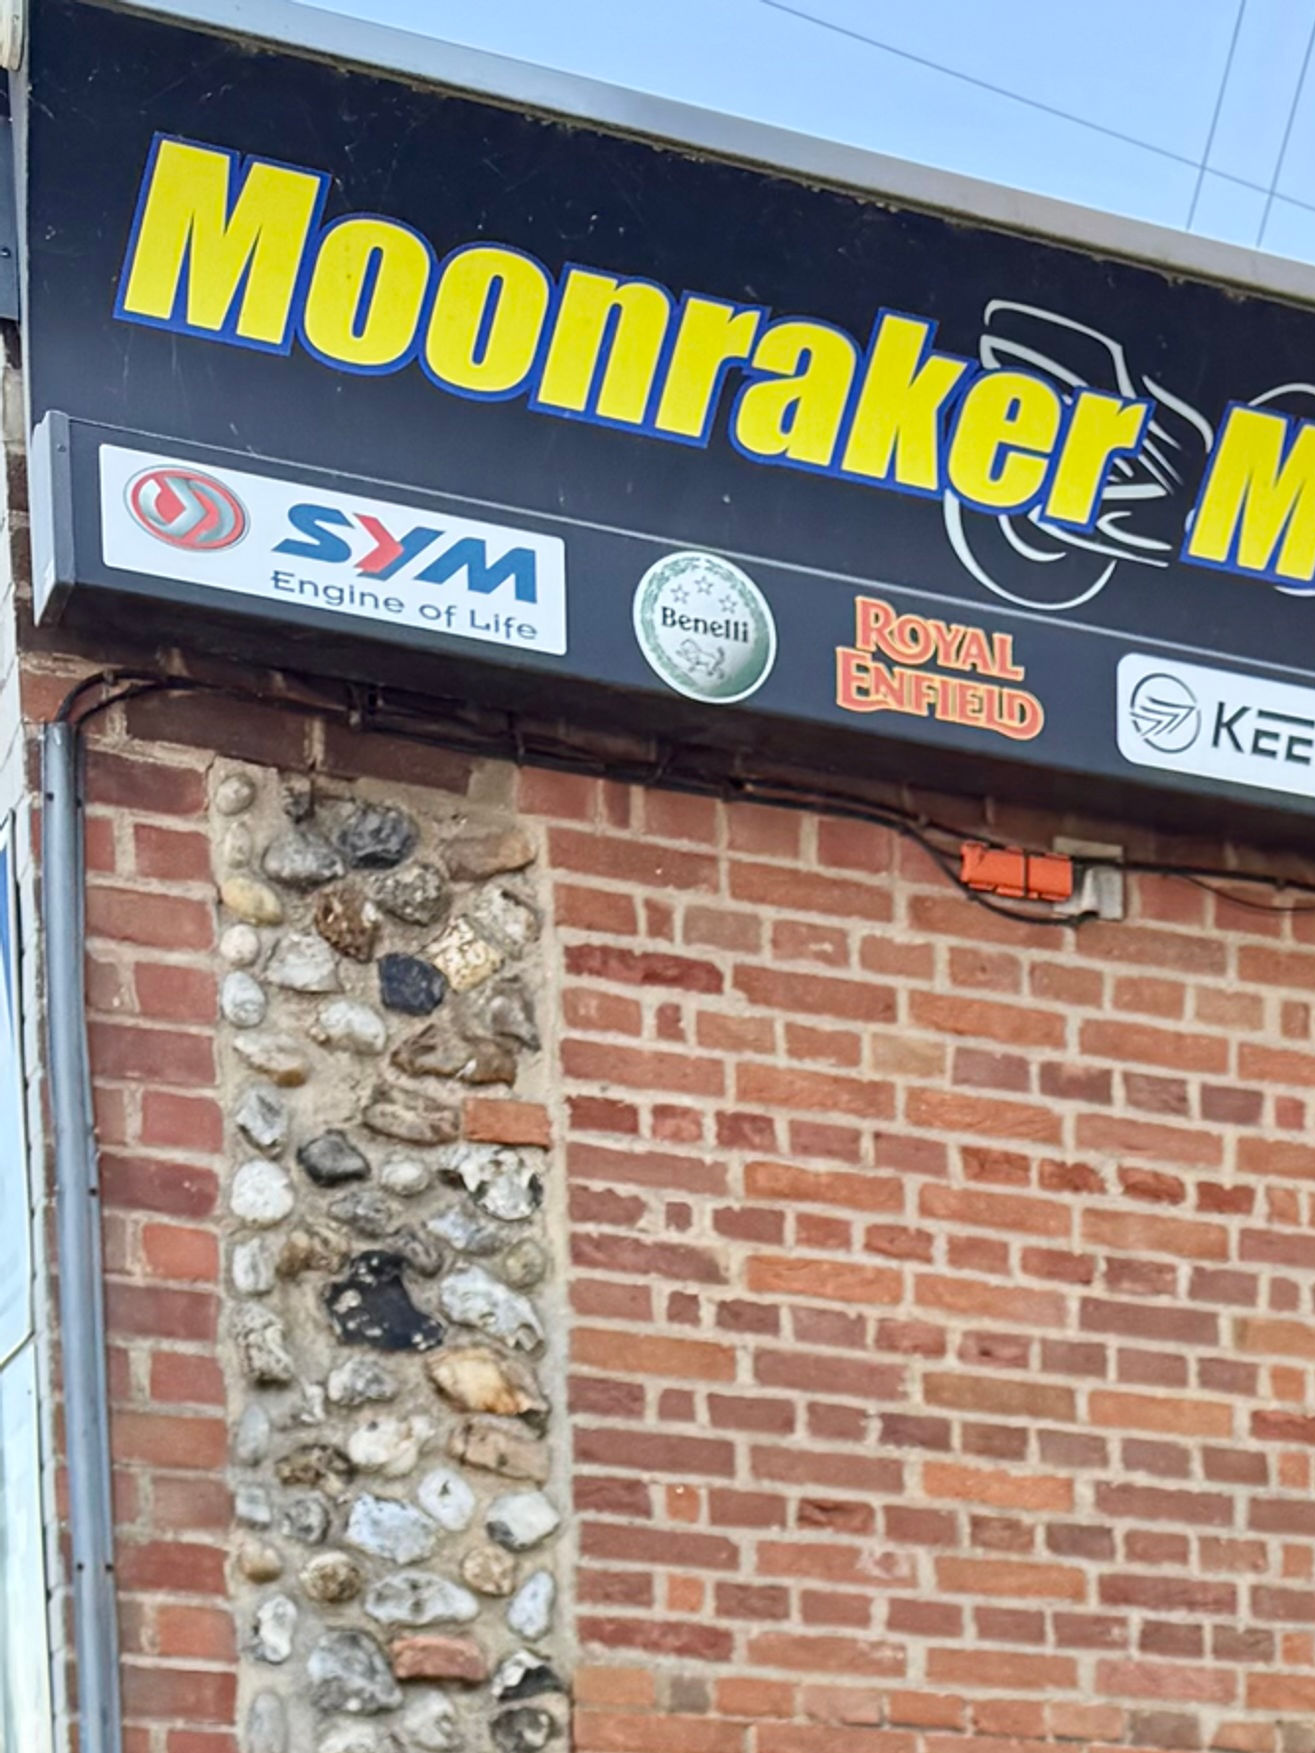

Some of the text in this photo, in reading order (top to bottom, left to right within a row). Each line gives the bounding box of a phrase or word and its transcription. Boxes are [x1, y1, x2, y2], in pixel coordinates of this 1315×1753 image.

[114, 132, 1155, 533] Moonraker
[272, 503, 537, 604] SYM
[272, 570, 538, 640] Engine of Life
[661, 605, 749, 644] Benelli
[854, 596, 1025, 681] ROYAL
[836, 647, 1045, 741] ENFIELD
